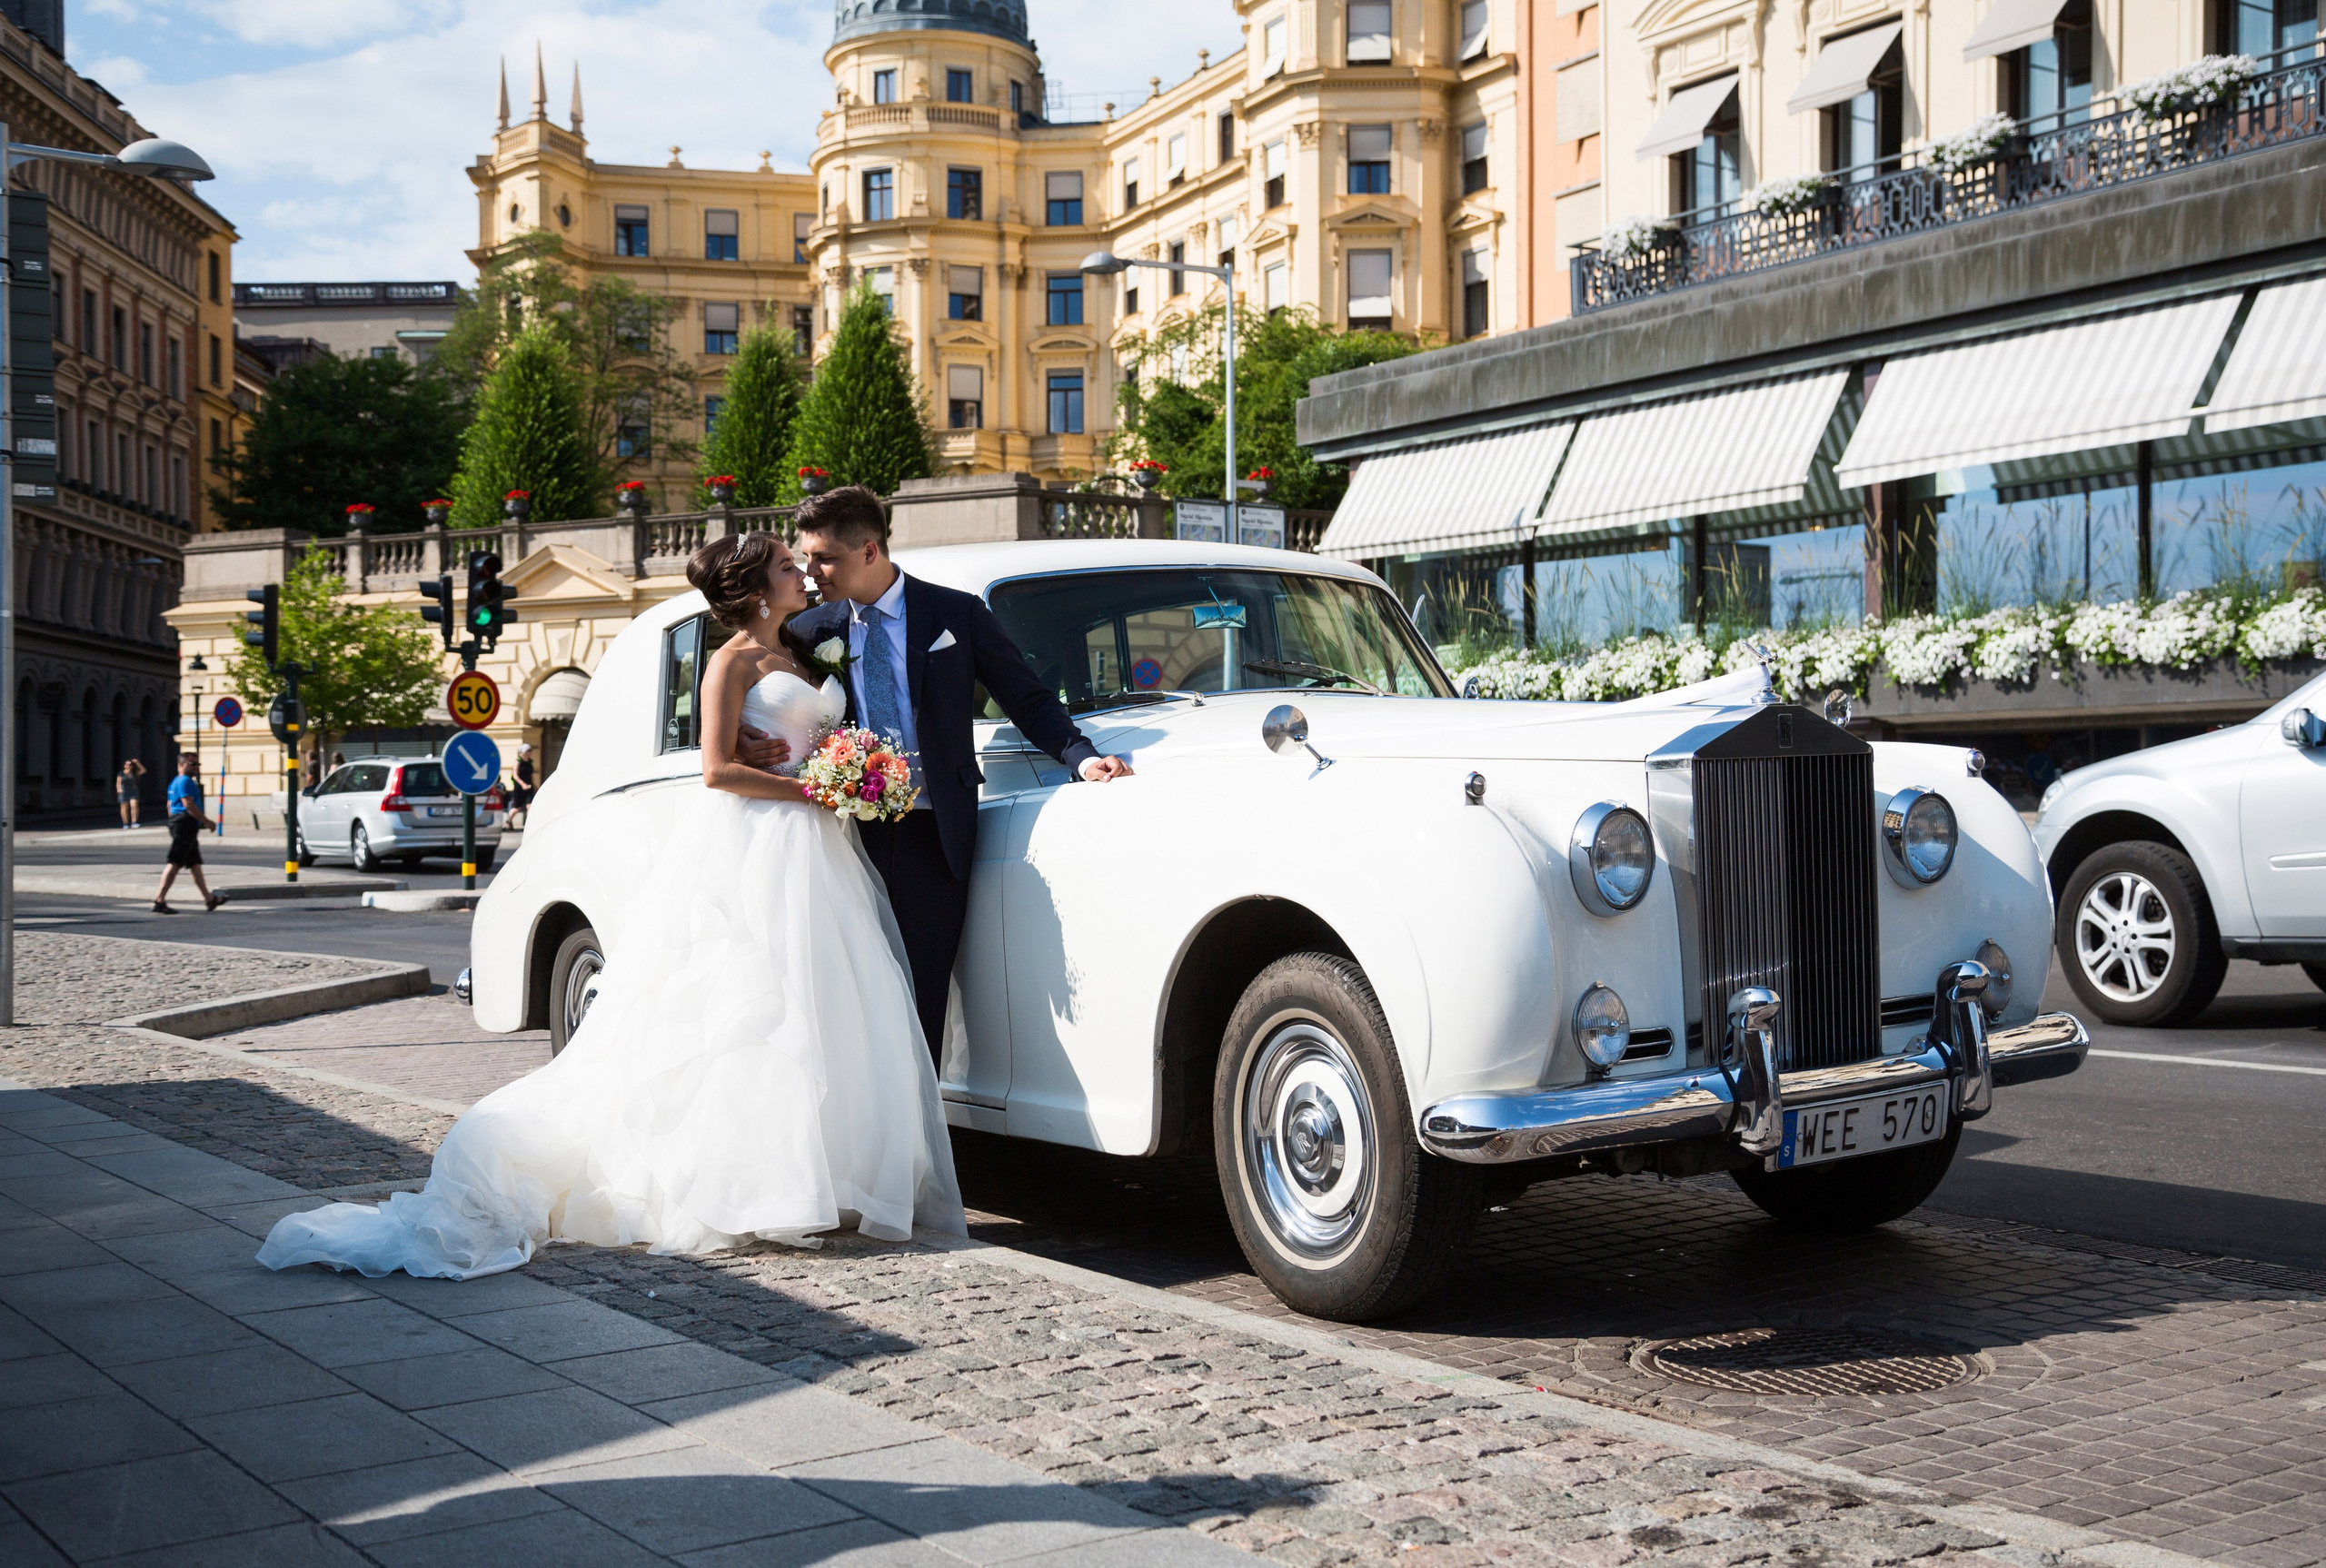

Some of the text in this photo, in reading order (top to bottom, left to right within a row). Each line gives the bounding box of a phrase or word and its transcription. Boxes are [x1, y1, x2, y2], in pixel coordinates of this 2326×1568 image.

[457, 687, 492, 715] 50
[1802, 1094, 1936, 1158] WEE 570
[1784, 1145, 1791, 1157] S
[1323, 1197, 1392, 1299] DECATHLON
